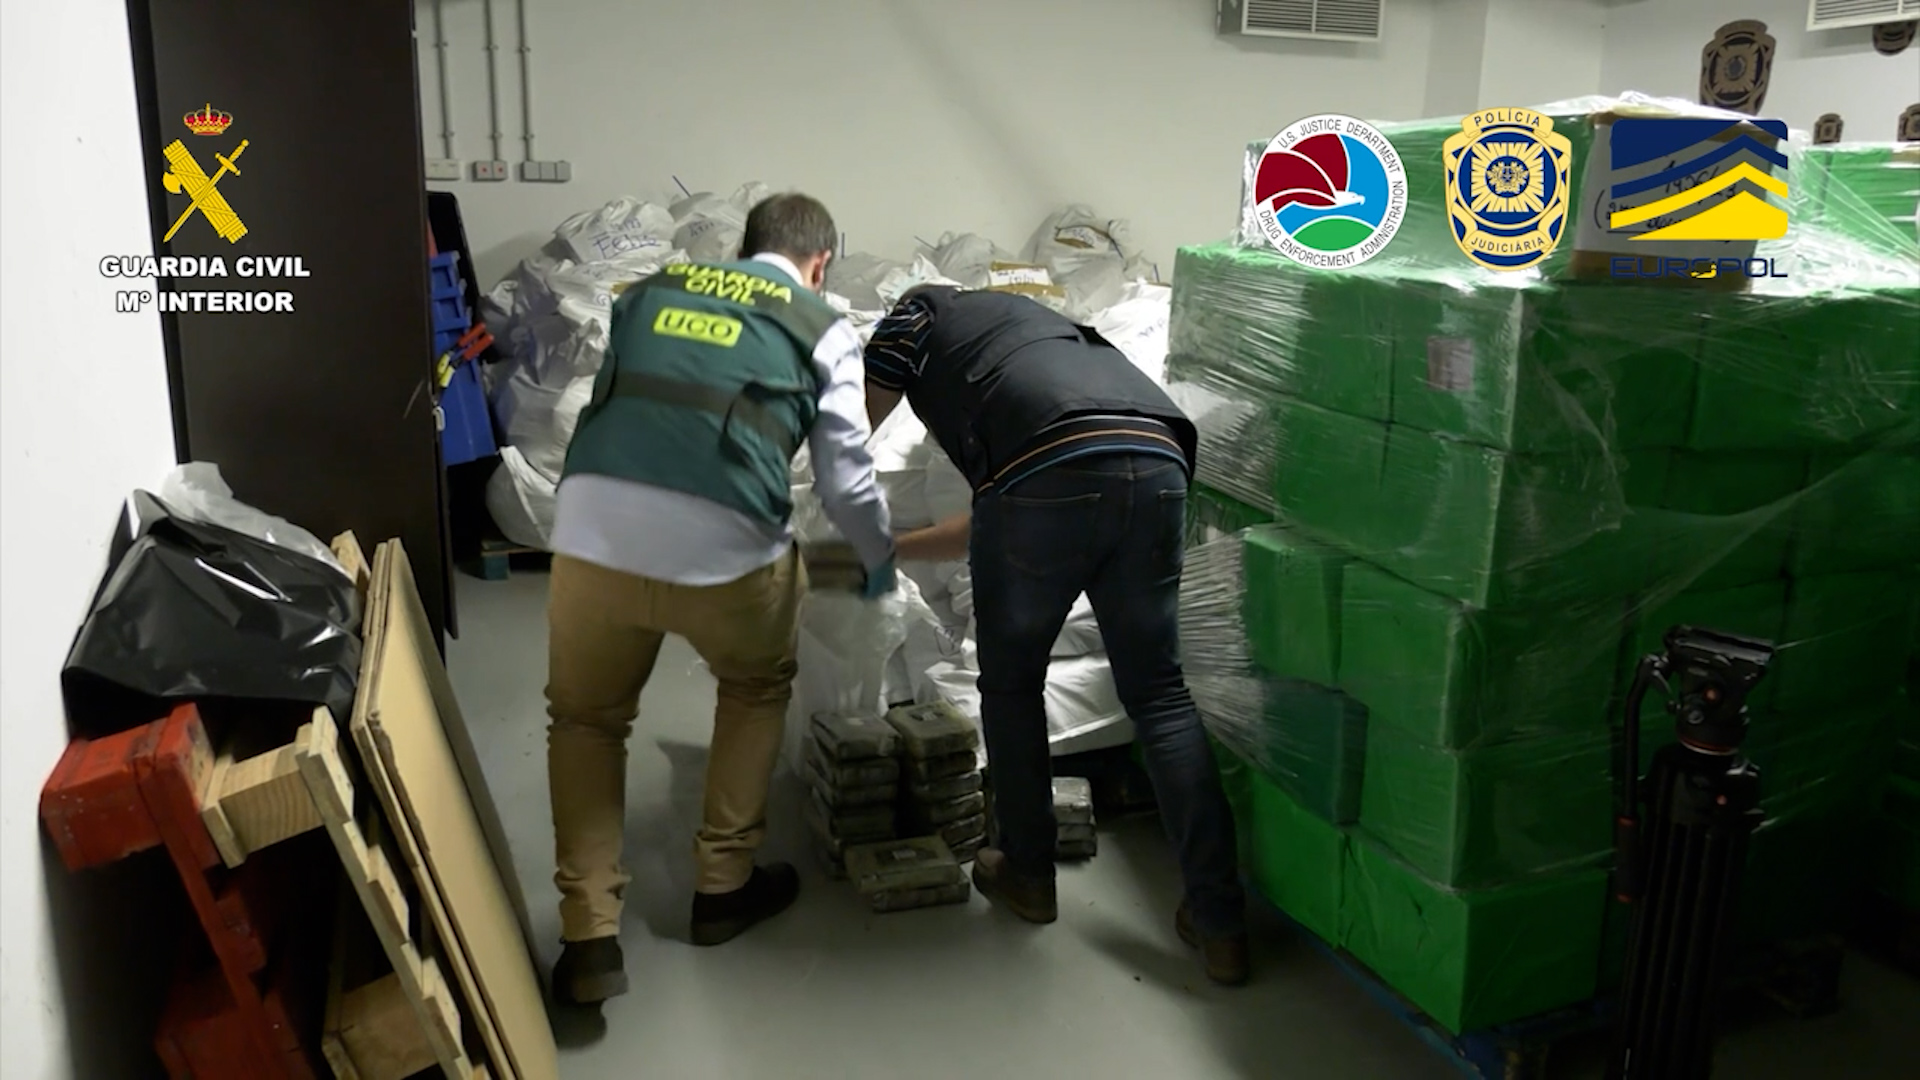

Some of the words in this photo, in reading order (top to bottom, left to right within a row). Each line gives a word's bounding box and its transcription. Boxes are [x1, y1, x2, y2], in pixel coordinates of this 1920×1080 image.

[666, 263, 792, 304] GUARDIA
[685, 277, 755, 306] CIVIL
[664, 312, 733, 339] UCO
